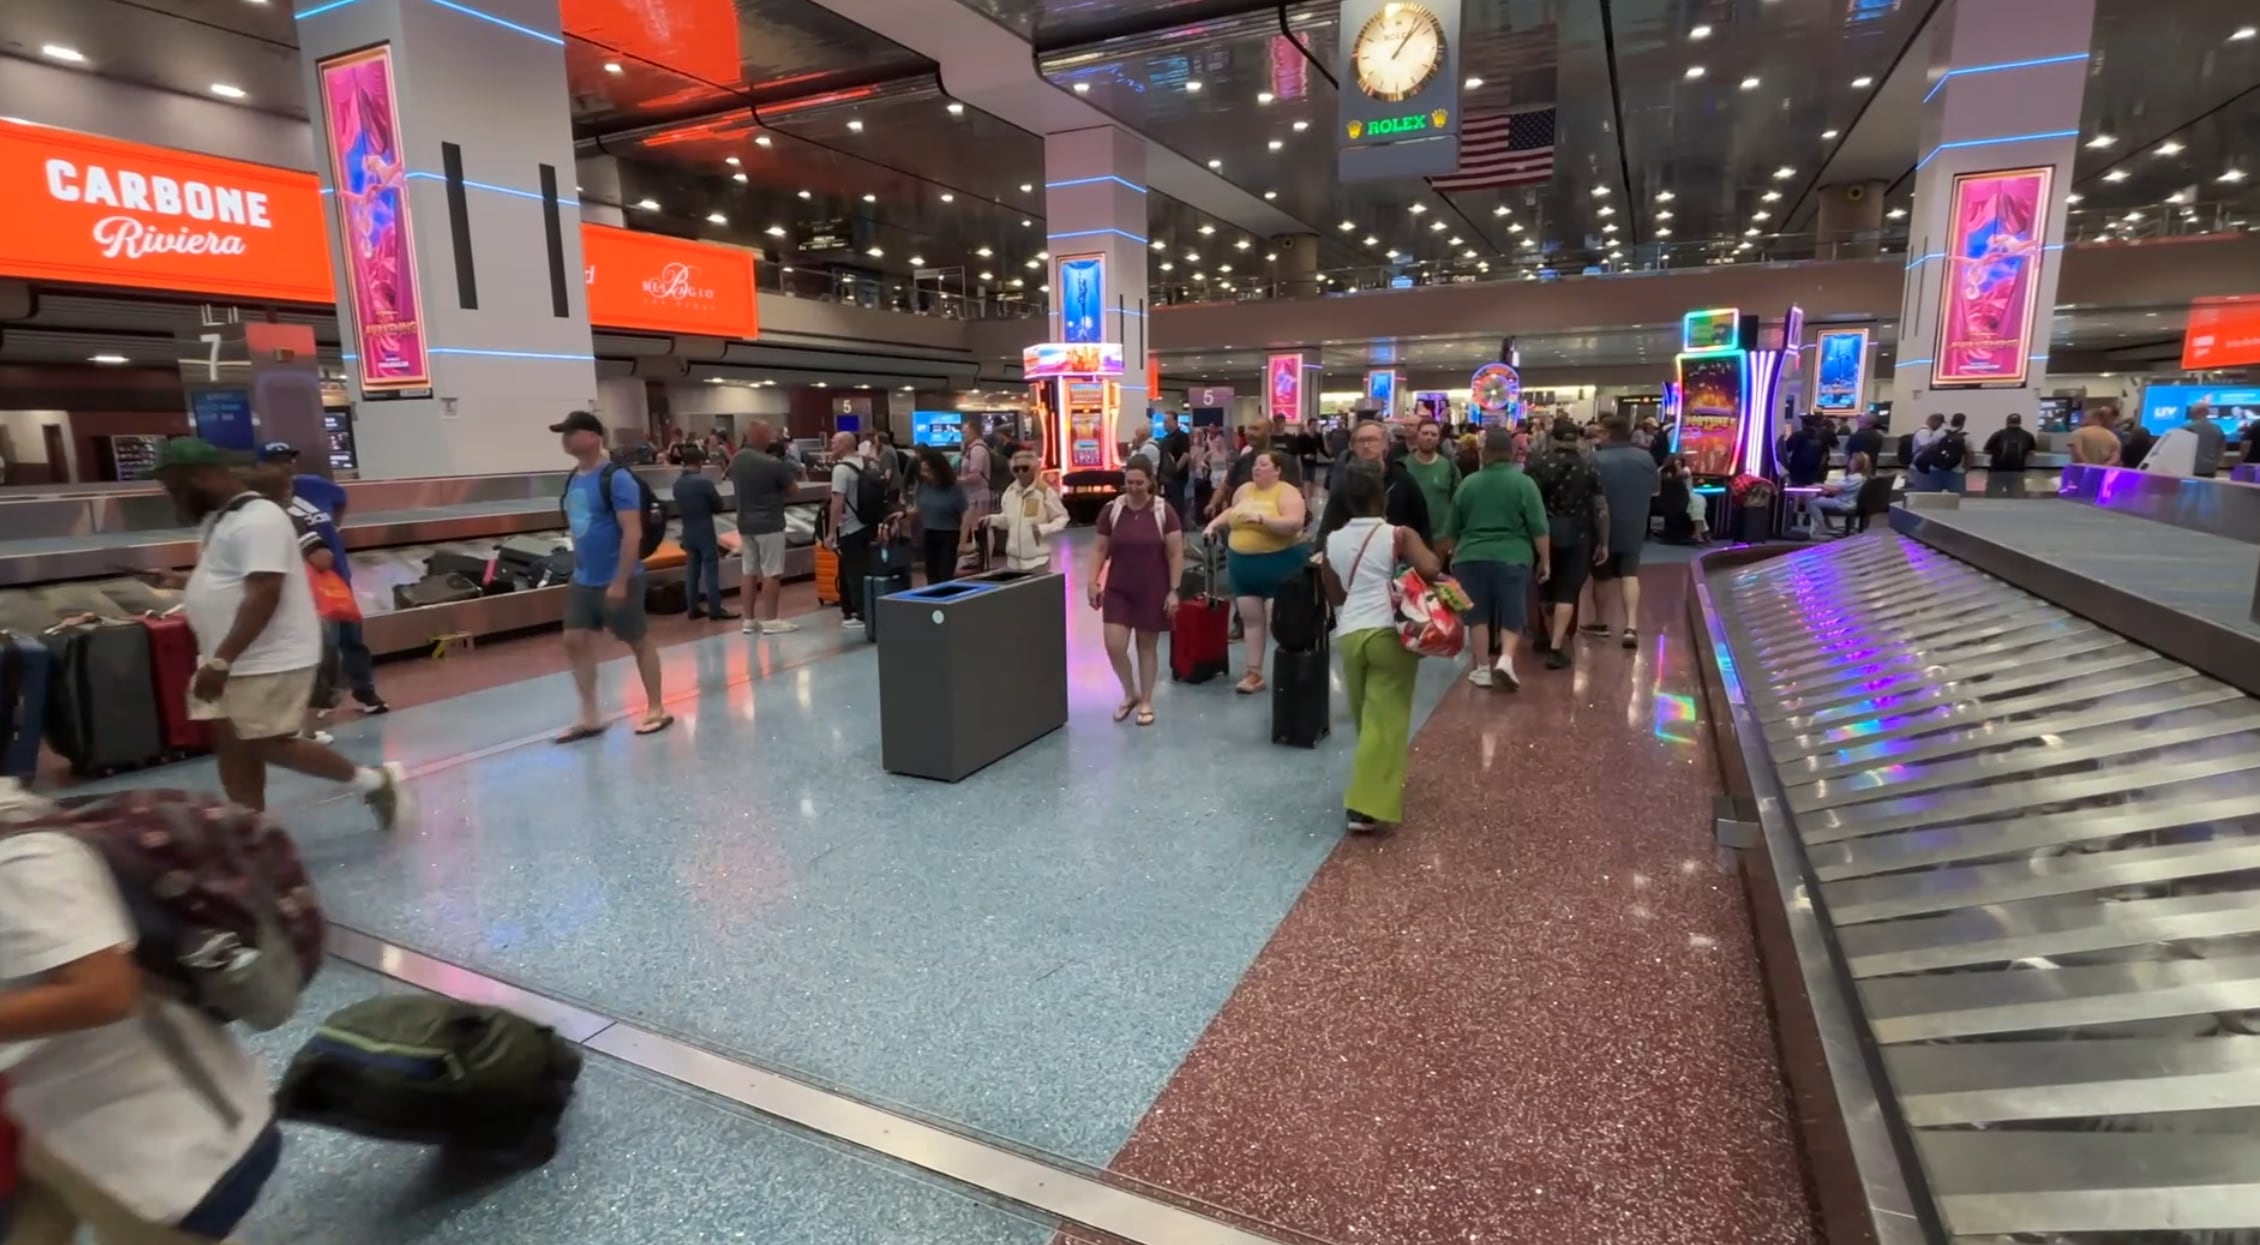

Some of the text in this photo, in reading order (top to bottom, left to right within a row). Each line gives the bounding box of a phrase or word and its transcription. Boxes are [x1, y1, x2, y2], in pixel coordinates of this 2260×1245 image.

[1367, 114, 1426, 136] ROLEX
[45, 158, 272, 230] CARBONE
[92, 215, 246, 259] Riviera
[200, 334, 221, 382] 7
[843, 400, 852, 414] 5
[1203, 389, 1214, 406] 5
